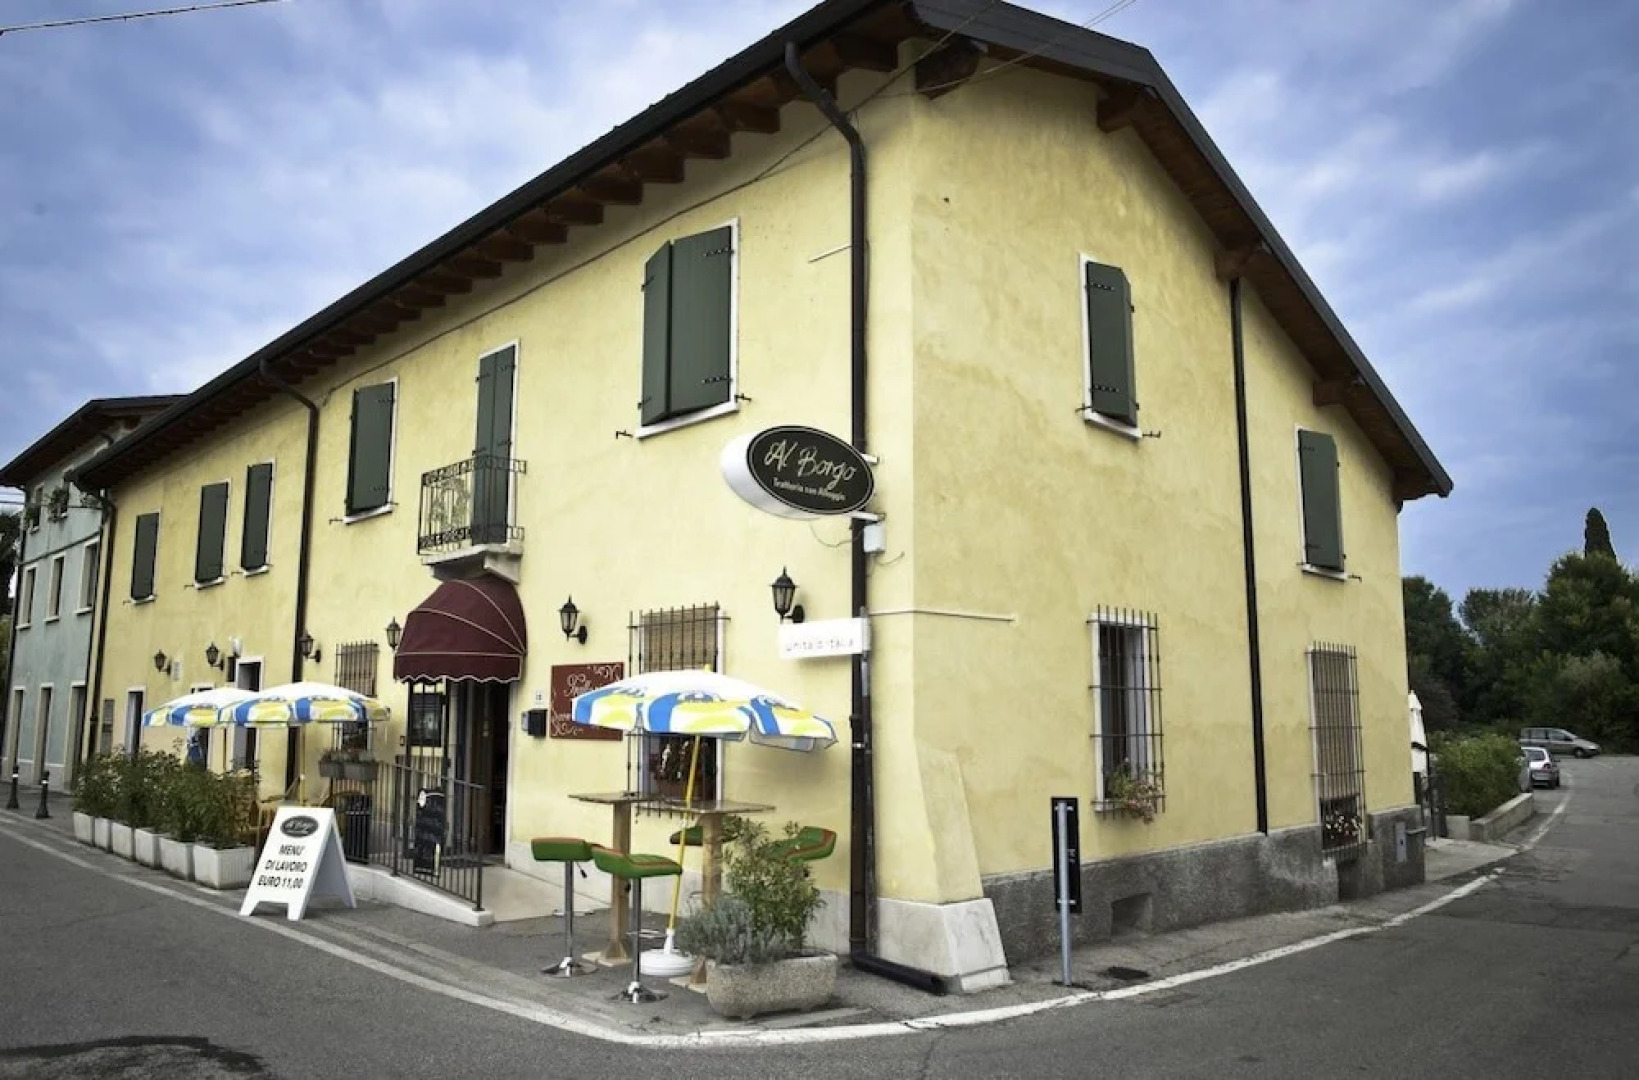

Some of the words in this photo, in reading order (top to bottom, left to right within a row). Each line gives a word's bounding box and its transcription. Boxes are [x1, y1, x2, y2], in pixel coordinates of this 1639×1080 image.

[763, 438, 798, 472] Al
[797, 446, 857, 491] Borgo
[265, 860, 275, 870] DI
[275, 861, 308, 872] LAVORO
[257, 875, 281, 887] EURO
